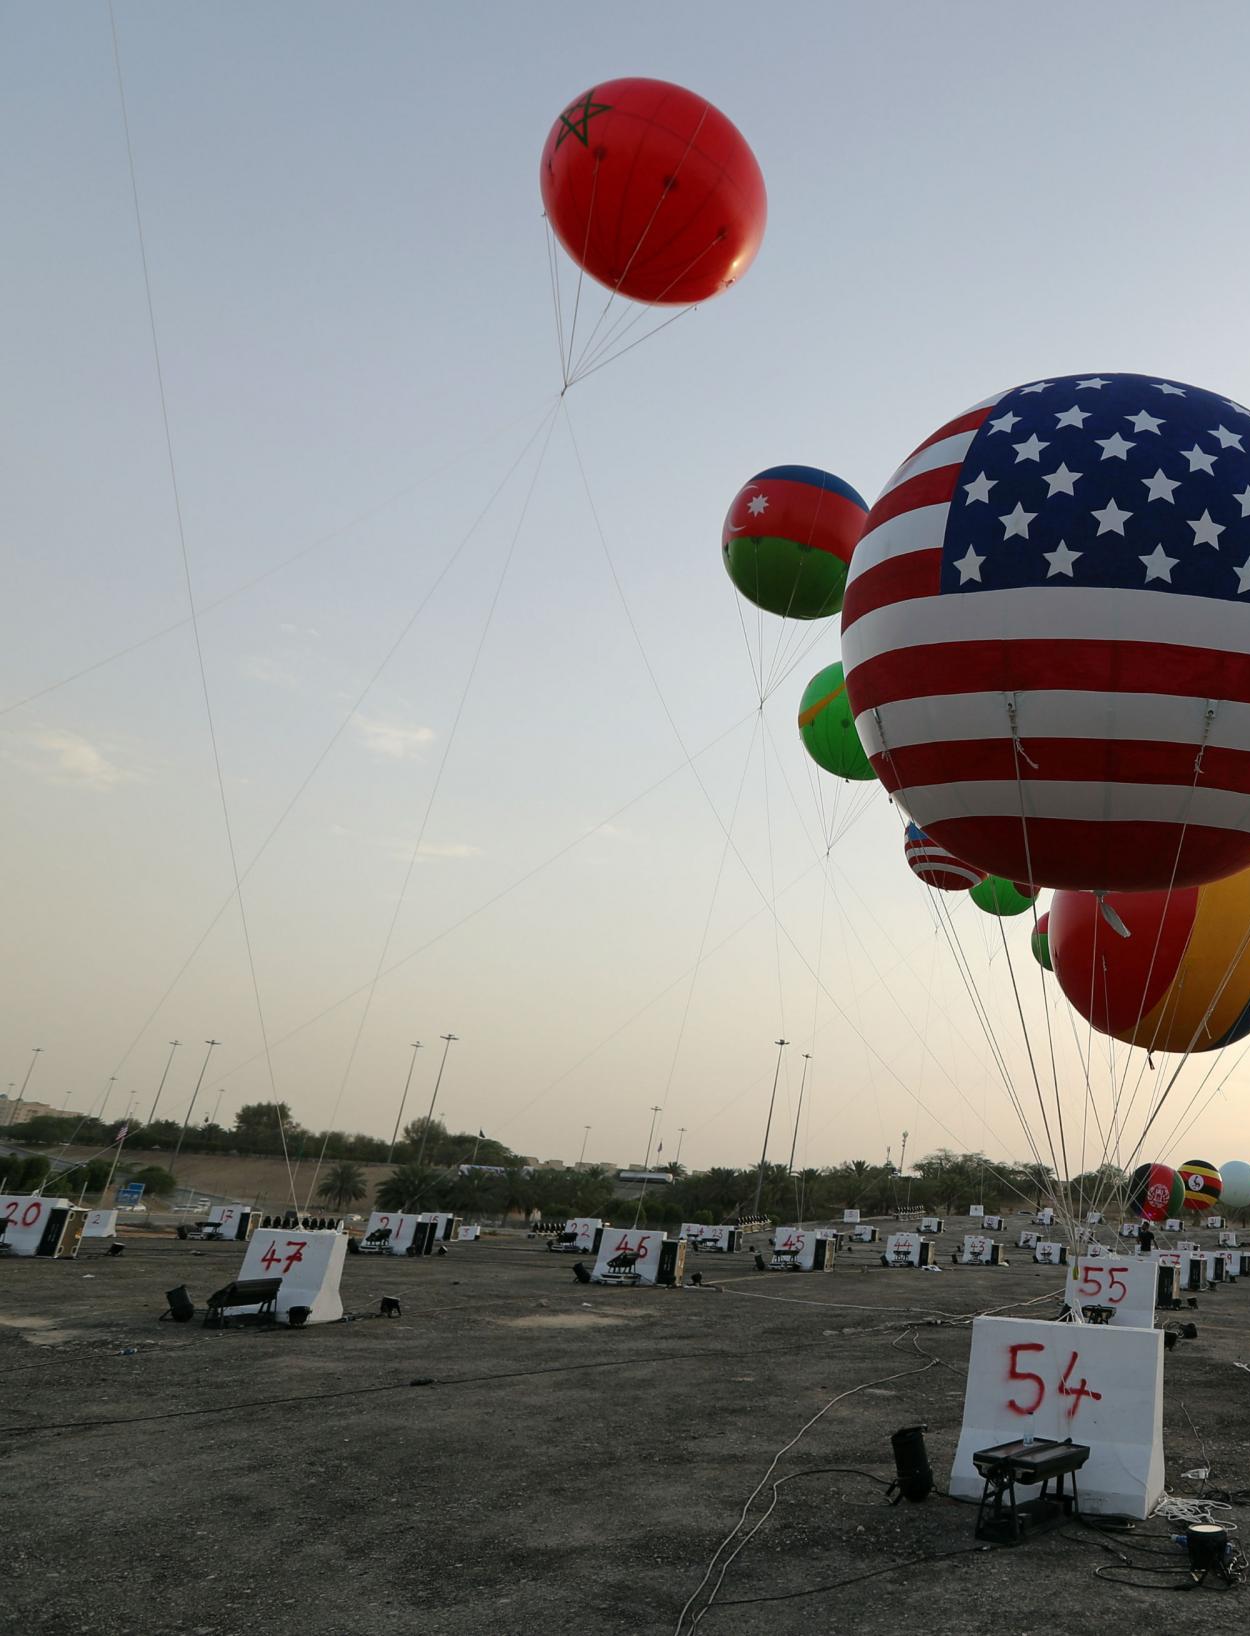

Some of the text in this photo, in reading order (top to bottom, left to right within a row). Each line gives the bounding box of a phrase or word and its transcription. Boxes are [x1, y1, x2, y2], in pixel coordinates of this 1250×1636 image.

[5, 1202, 42, 1227] 20
[783, 1234, 805, 1251] 45
[894, 1238, 913, 1251] 44
[970, 1240, 985, 1252] 43
[261, 1240, 308, 1274] 47
[1077, 1266, 1129, 1304] 55
[1007, 1342, 1102, 1419] 54
